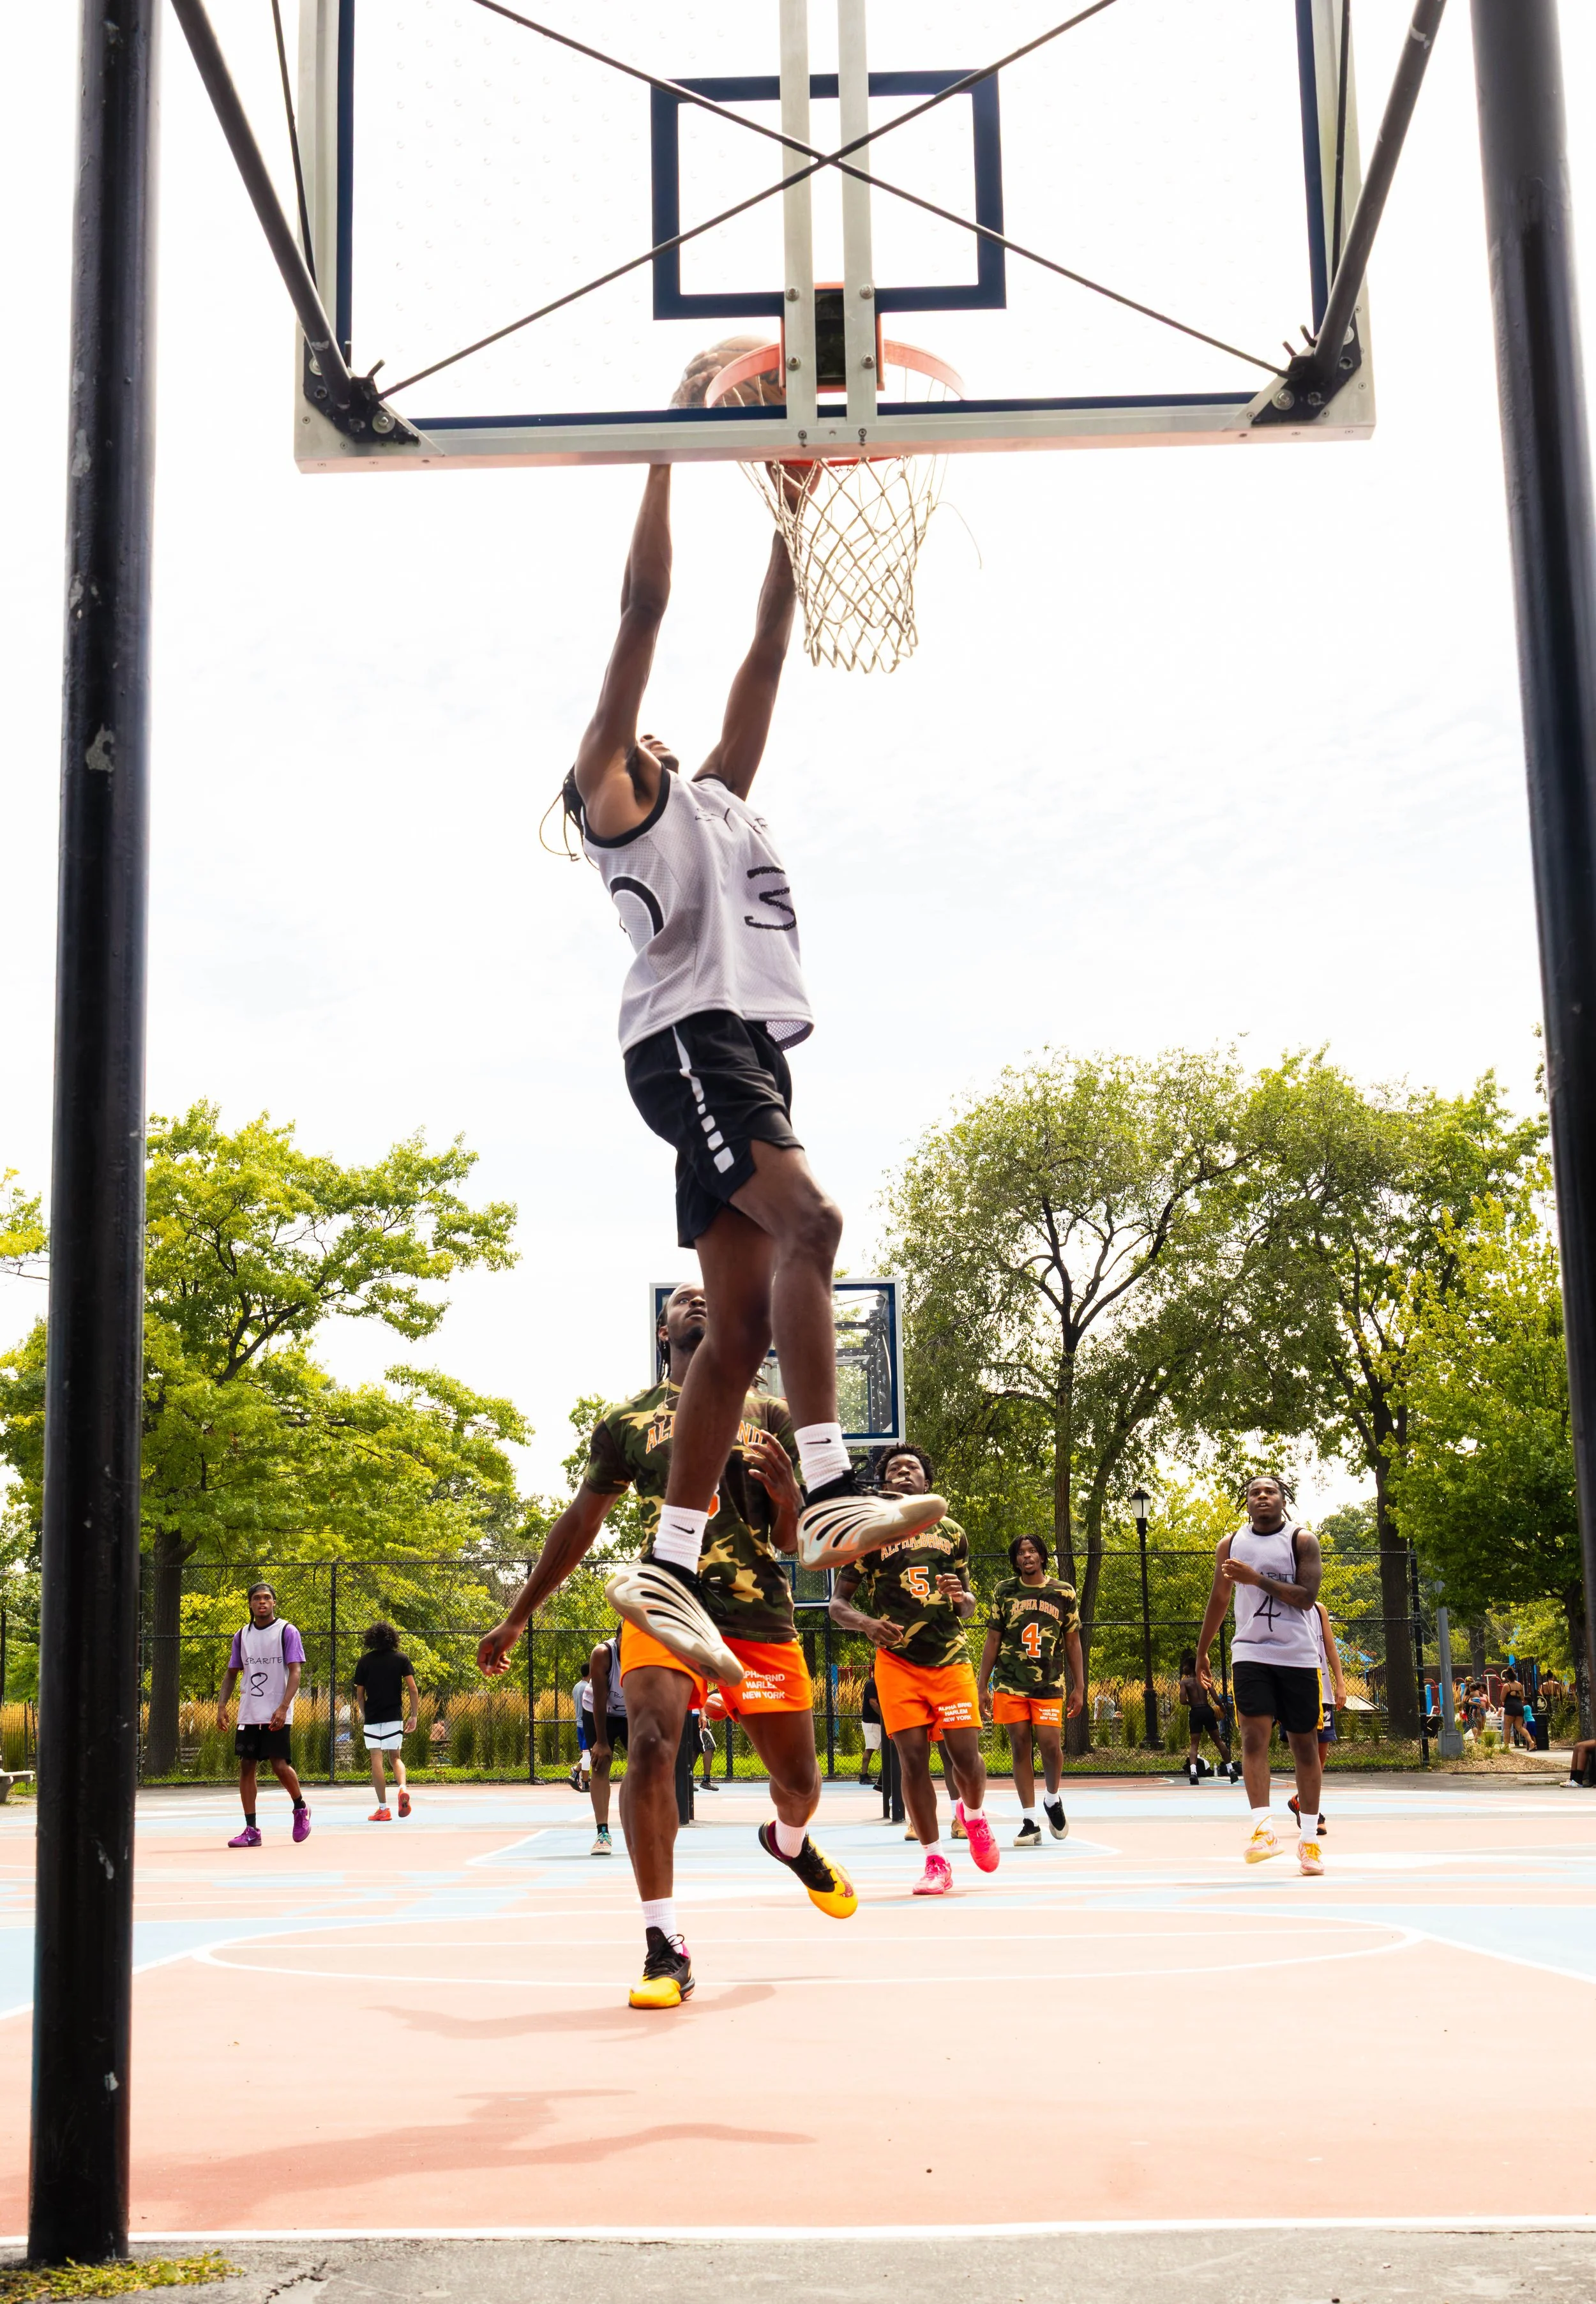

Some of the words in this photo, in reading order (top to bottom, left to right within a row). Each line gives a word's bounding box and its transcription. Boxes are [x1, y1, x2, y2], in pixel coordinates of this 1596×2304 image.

[745, 866, 797, 931] 3
[919, 1533, 951, 1556] BRND
[908, 1566, 931, 1598] 5
[1011, 1599, 1037, 1616] ALPHA
[1039, 1600, 1059, 1620] BRND
[1253, 1595, 1281, 1632] 4
[1021, 1622, 1042, 1659] 4
[250, 1672, 268, 1697] 8
[742, 1691, 762, 1700] NEW
[746, 1681, 777, 1689] HARLE
